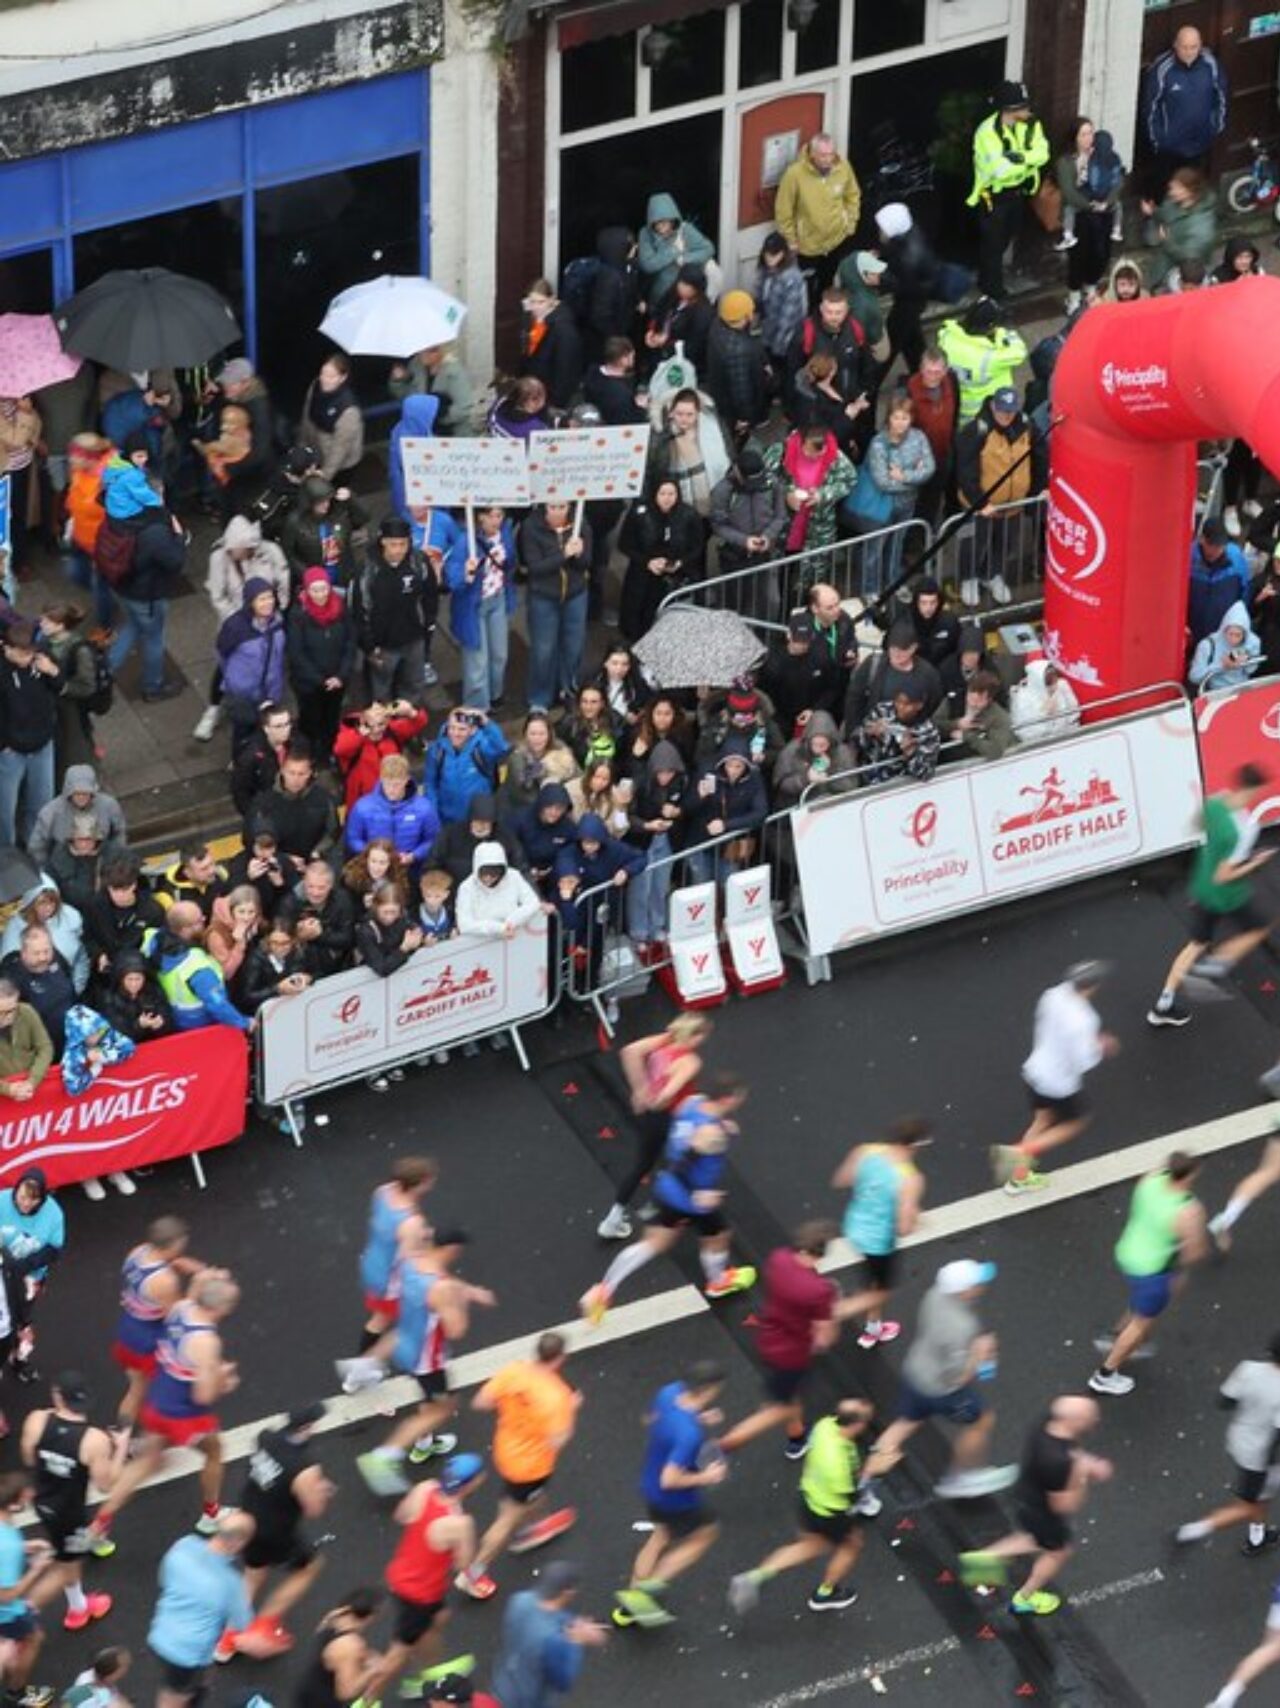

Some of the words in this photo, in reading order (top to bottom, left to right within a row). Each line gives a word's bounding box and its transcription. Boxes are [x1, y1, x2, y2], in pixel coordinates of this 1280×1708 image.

[991, 825, 1074, 862] CARDIFF
[1079, 808, 1129, 838] HALF
[883, 858, 969, 894] Principality
[395, 1000, 456, 1027] CARDIFF
[460, 984, 498, 1006] HALF
[0, 1110, 54, 1151] UN
